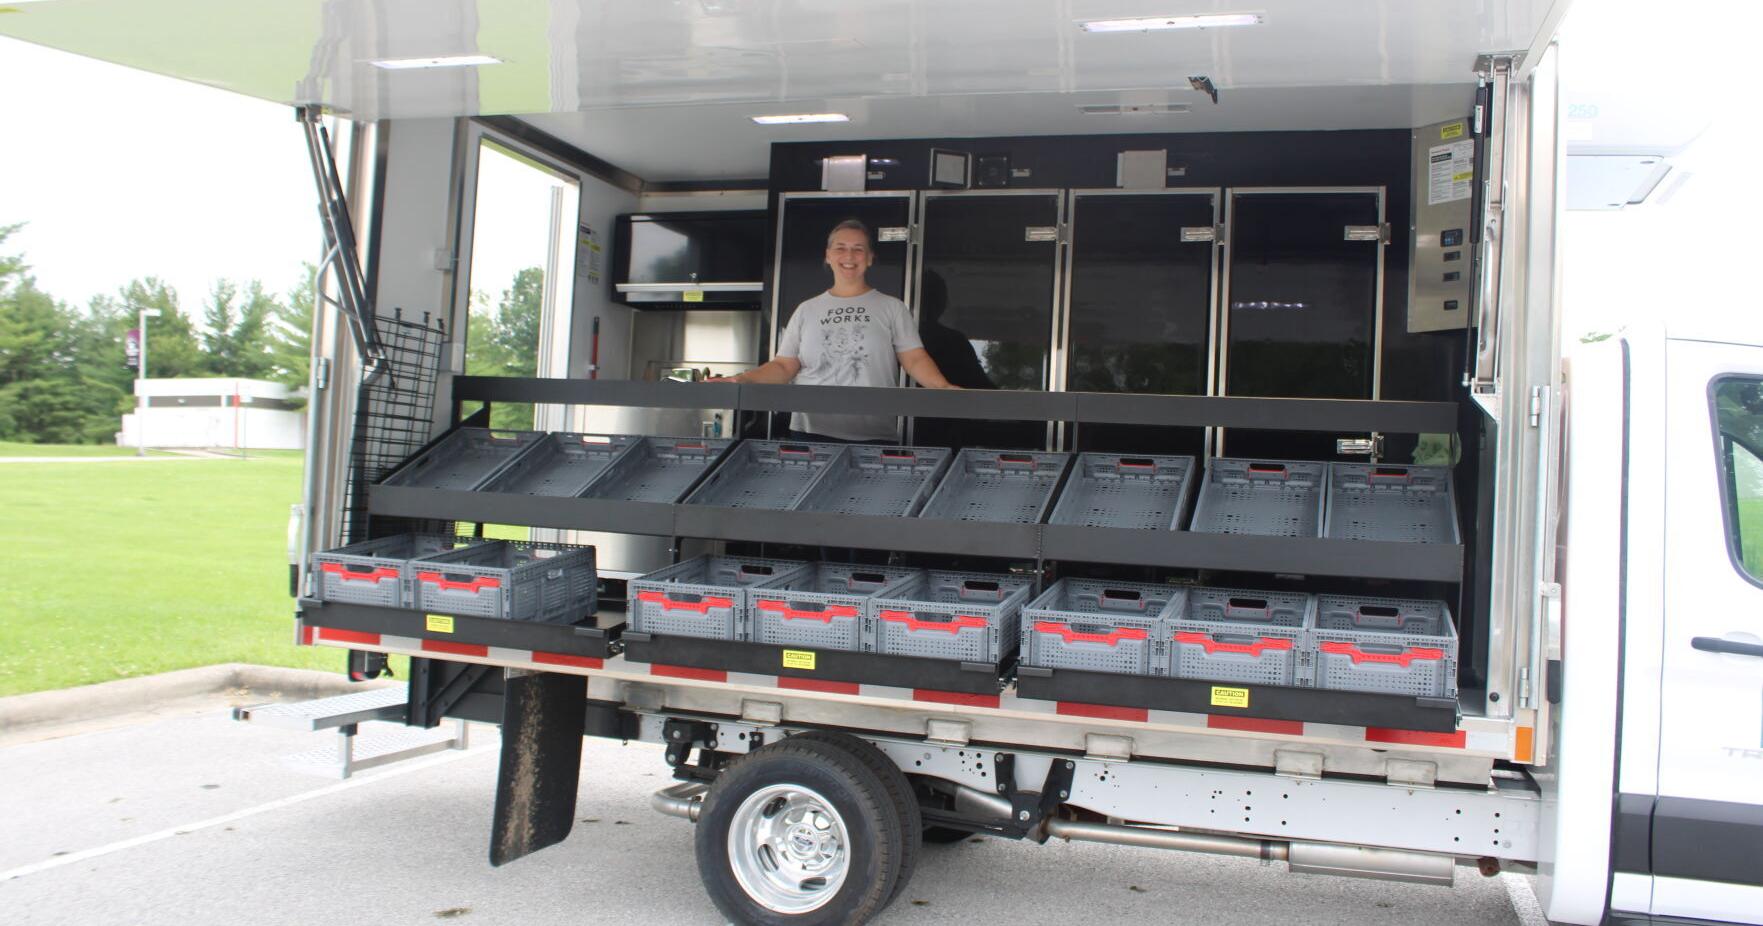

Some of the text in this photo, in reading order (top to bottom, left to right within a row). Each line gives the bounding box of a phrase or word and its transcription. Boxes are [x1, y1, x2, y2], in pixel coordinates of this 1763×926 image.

[827, 306, 866, 316] FOOD
[820, 315, 871, 325] WORKS
[1214, 689, 1245, 698] CAUTION
